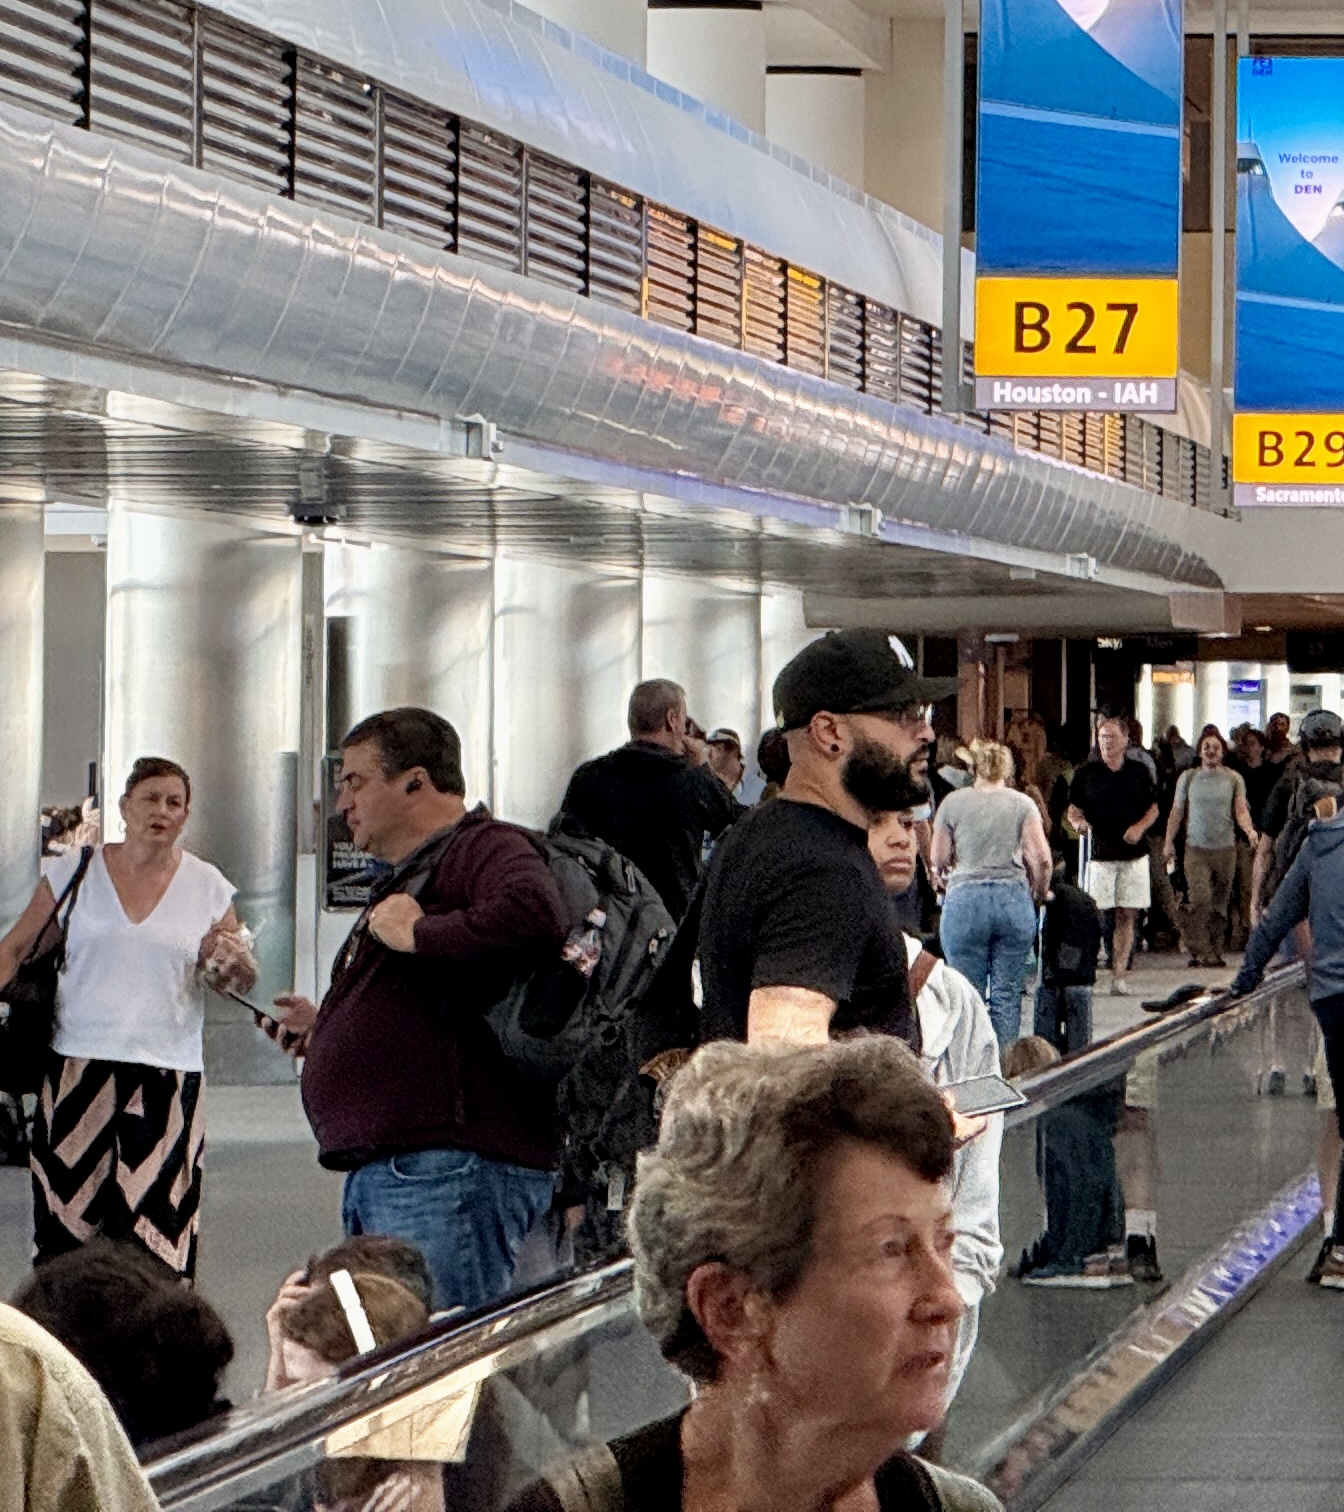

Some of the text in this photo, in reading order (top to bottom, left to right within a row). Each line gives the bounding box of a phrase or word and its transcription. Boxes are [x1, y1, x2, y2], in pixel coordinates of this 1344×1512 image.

[1278, 152, 1339, 164] Welcome
[1300, 169, 1314, 179] to
[1293, 184, 1323, 195] DEN
[1013, 301, 1140, 355] B27
[992, 382, 1091, 405] Houston
[1113, 382, 1159, 405] IAH
